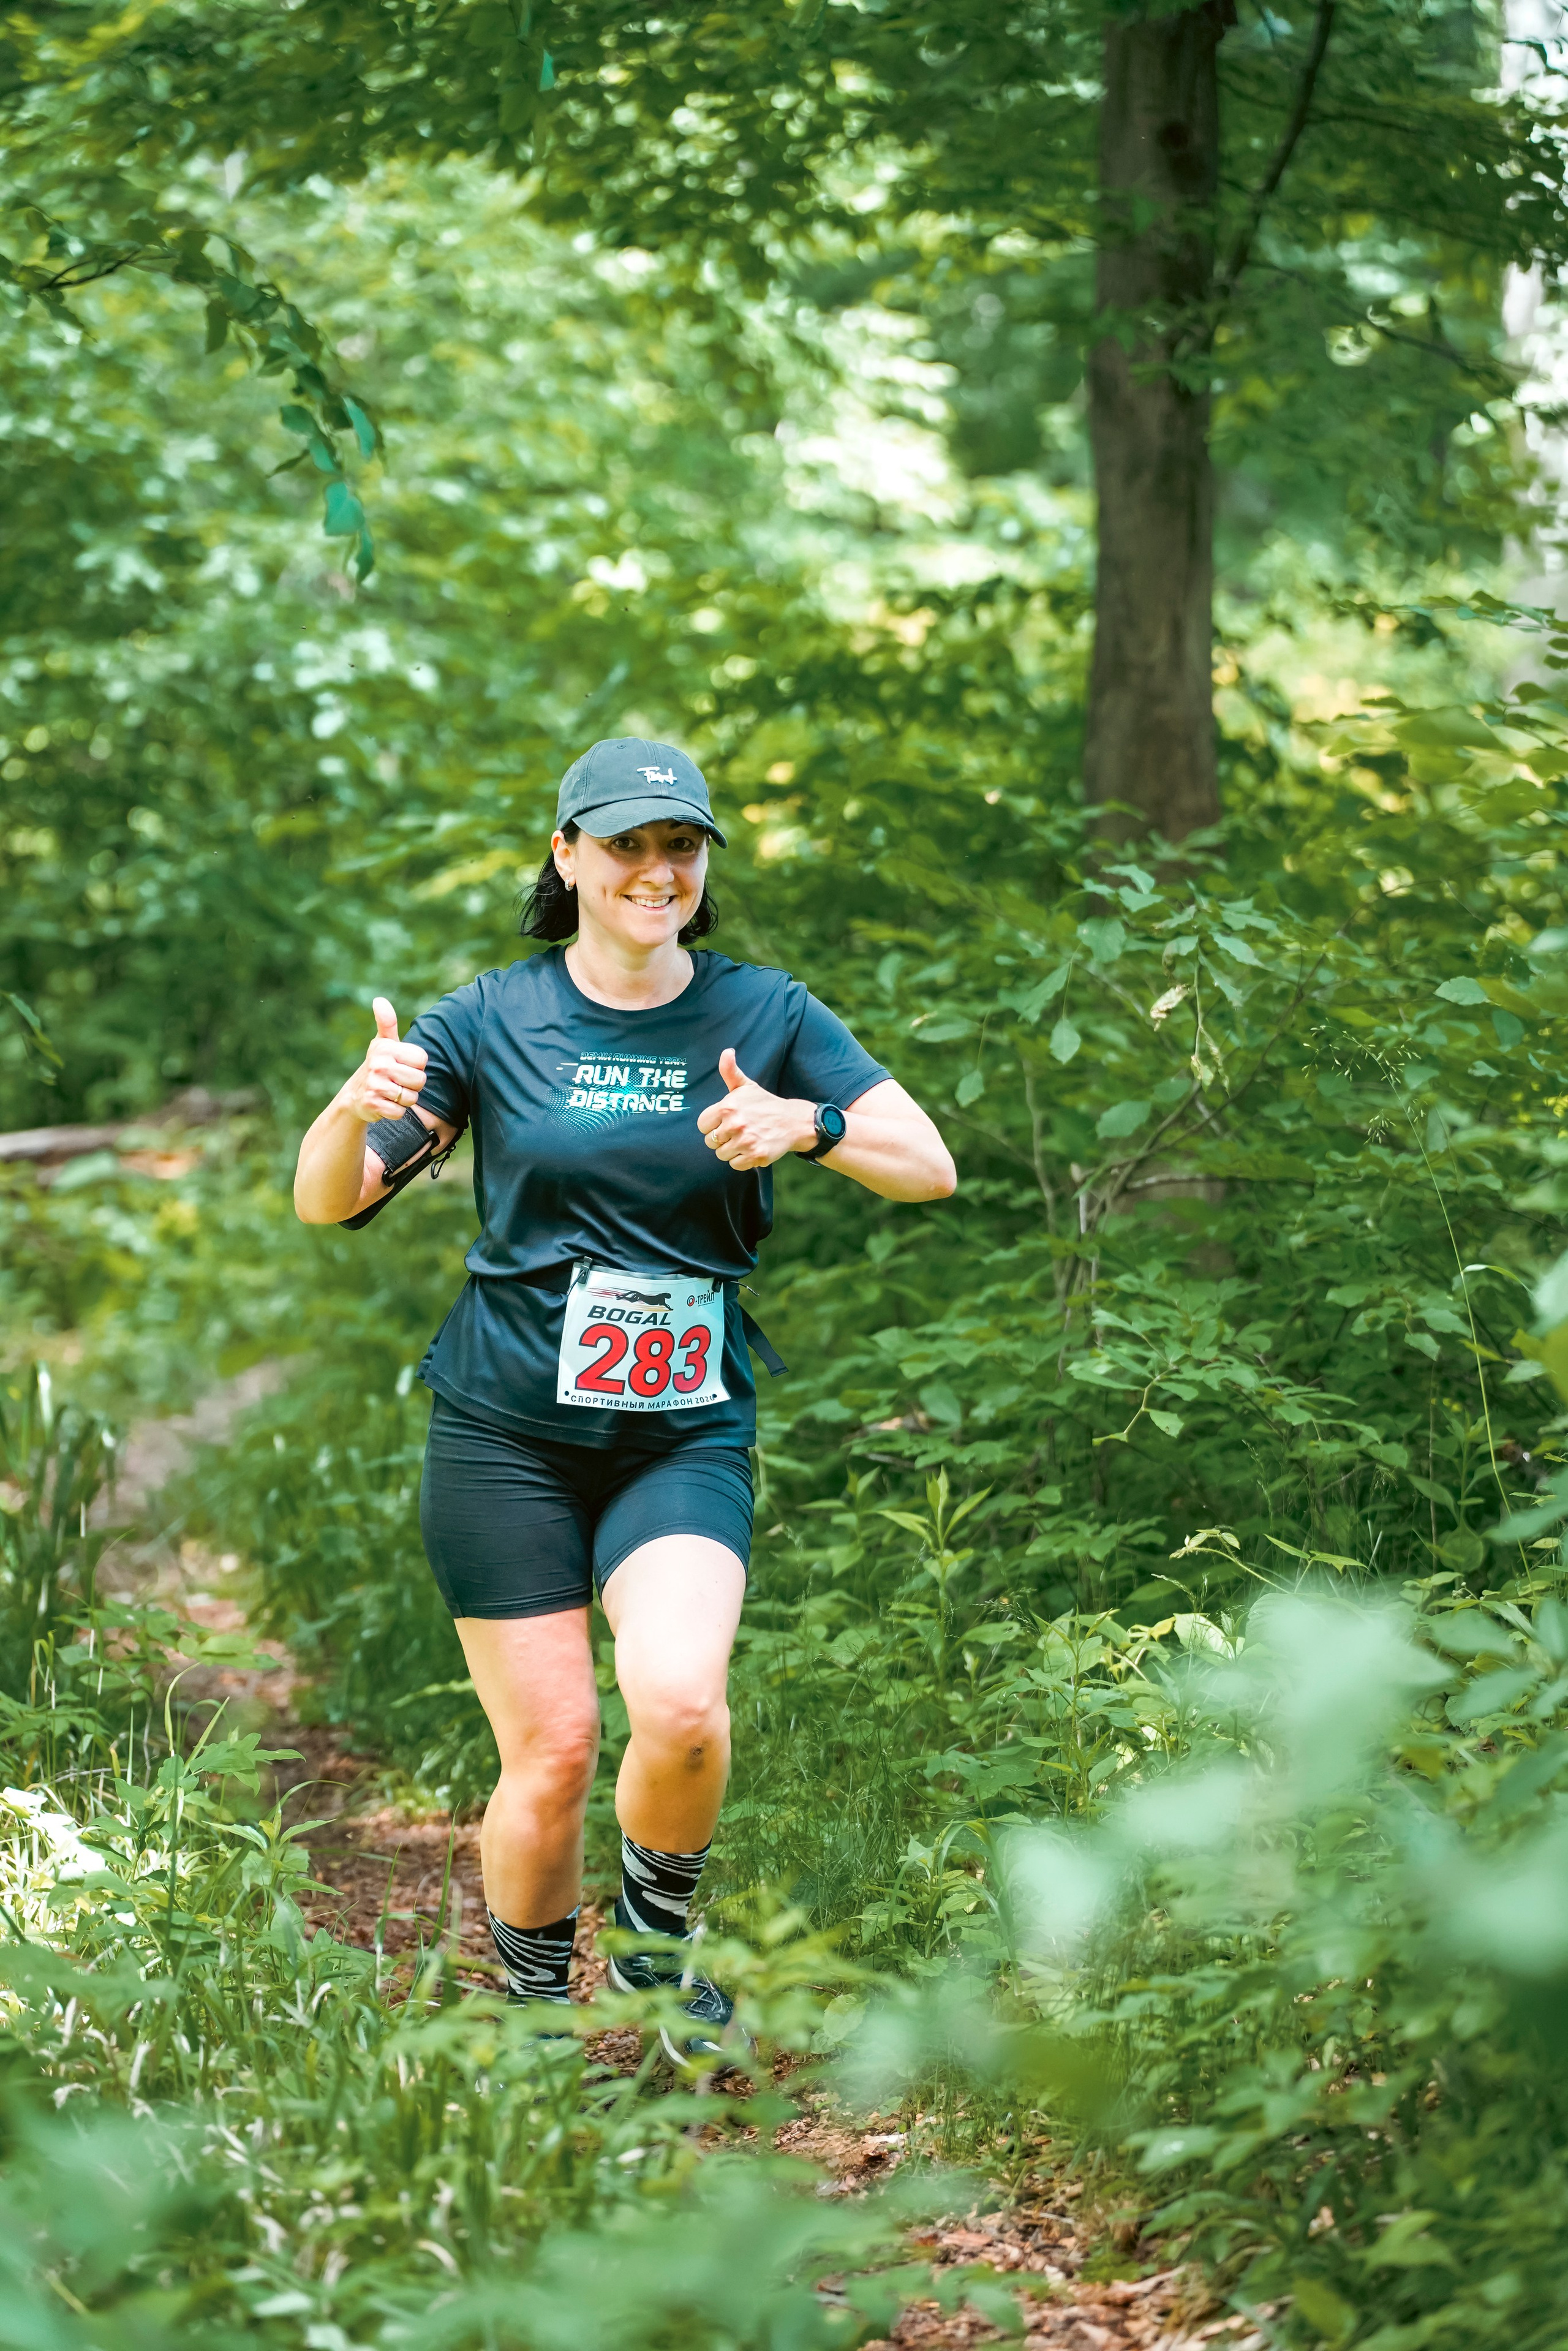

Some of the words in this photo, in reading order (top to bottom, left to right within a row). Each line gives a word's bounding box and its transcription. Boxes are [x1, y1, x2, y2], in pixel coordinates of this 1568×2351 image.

[580, 1051, 612, 1061] DEMIX
[612, 1052, 657, 1064] RUNNING
[658, 1056, 687, 1066] TEAM
[572, 1065, 630, 1087] RUN
[635, 1067, 688, 1089] THE
[567, 1089, 688, 1112] DISTANCE
[587, 1305, 672, 1326] BOGAL
[575, 1323, 712, 1398] 283
[571, 1395, 644, 1409] СПОРТИВНЫЙ
[647, 1398, 693, 1409] МАРАФОН
